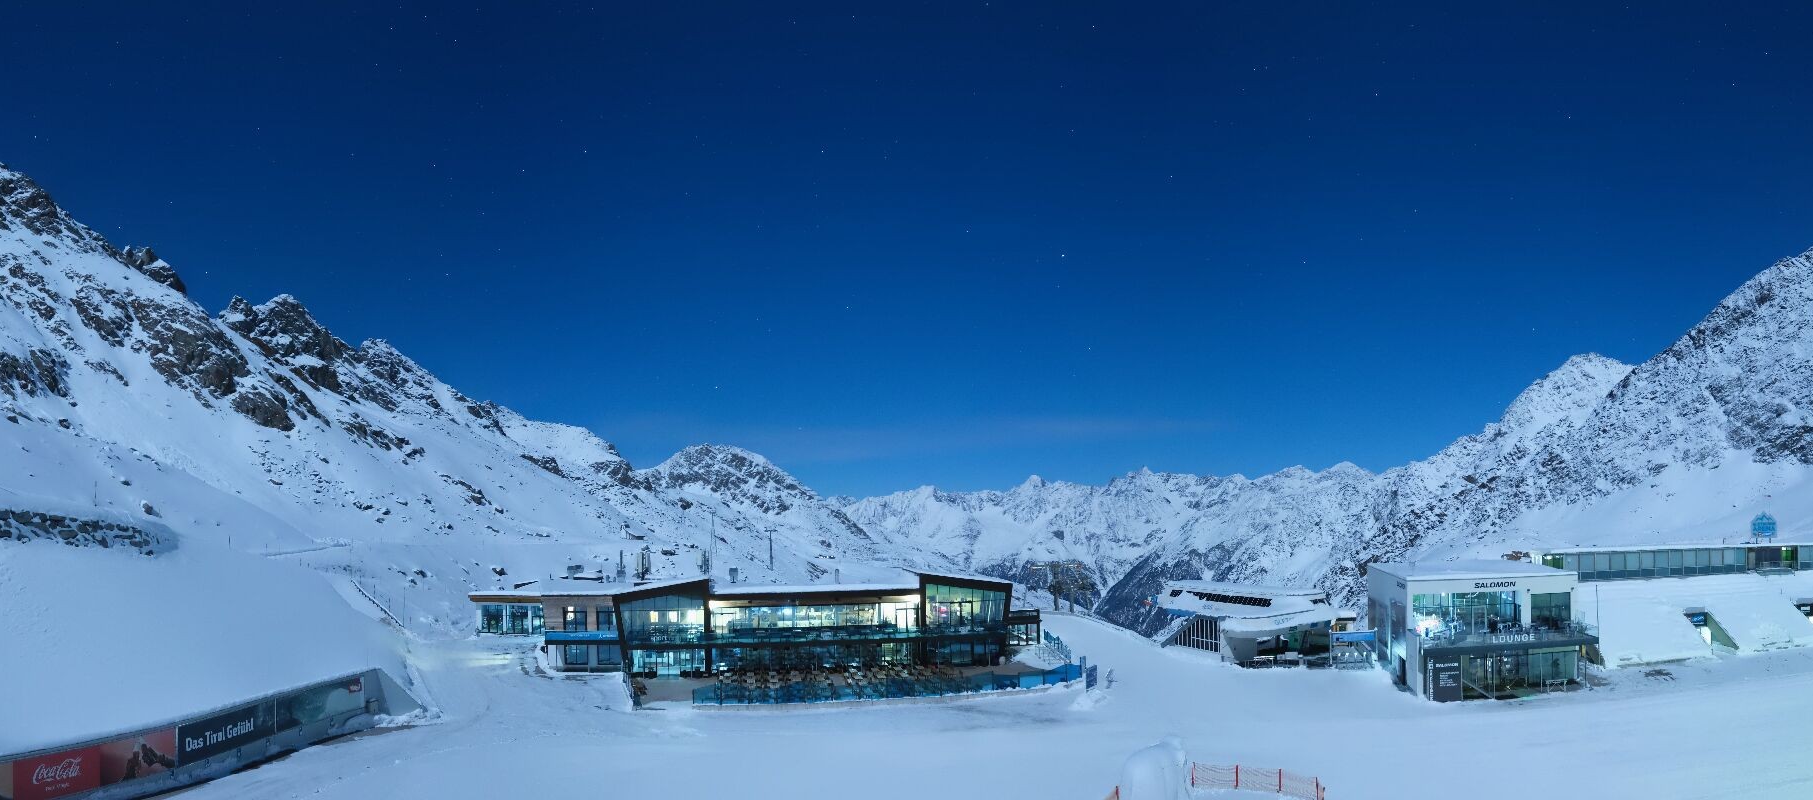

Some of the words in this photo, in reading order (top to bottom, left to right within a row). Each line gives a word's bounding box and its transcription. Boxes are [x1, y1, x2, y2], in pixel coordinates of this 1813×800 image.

[1492, 633, 1535, 643] LOUNGE
[185, 737, 204, 752] Das
[205, 726, 226, 746] Tirol
[227, 717, 254, 739] Gefühl
